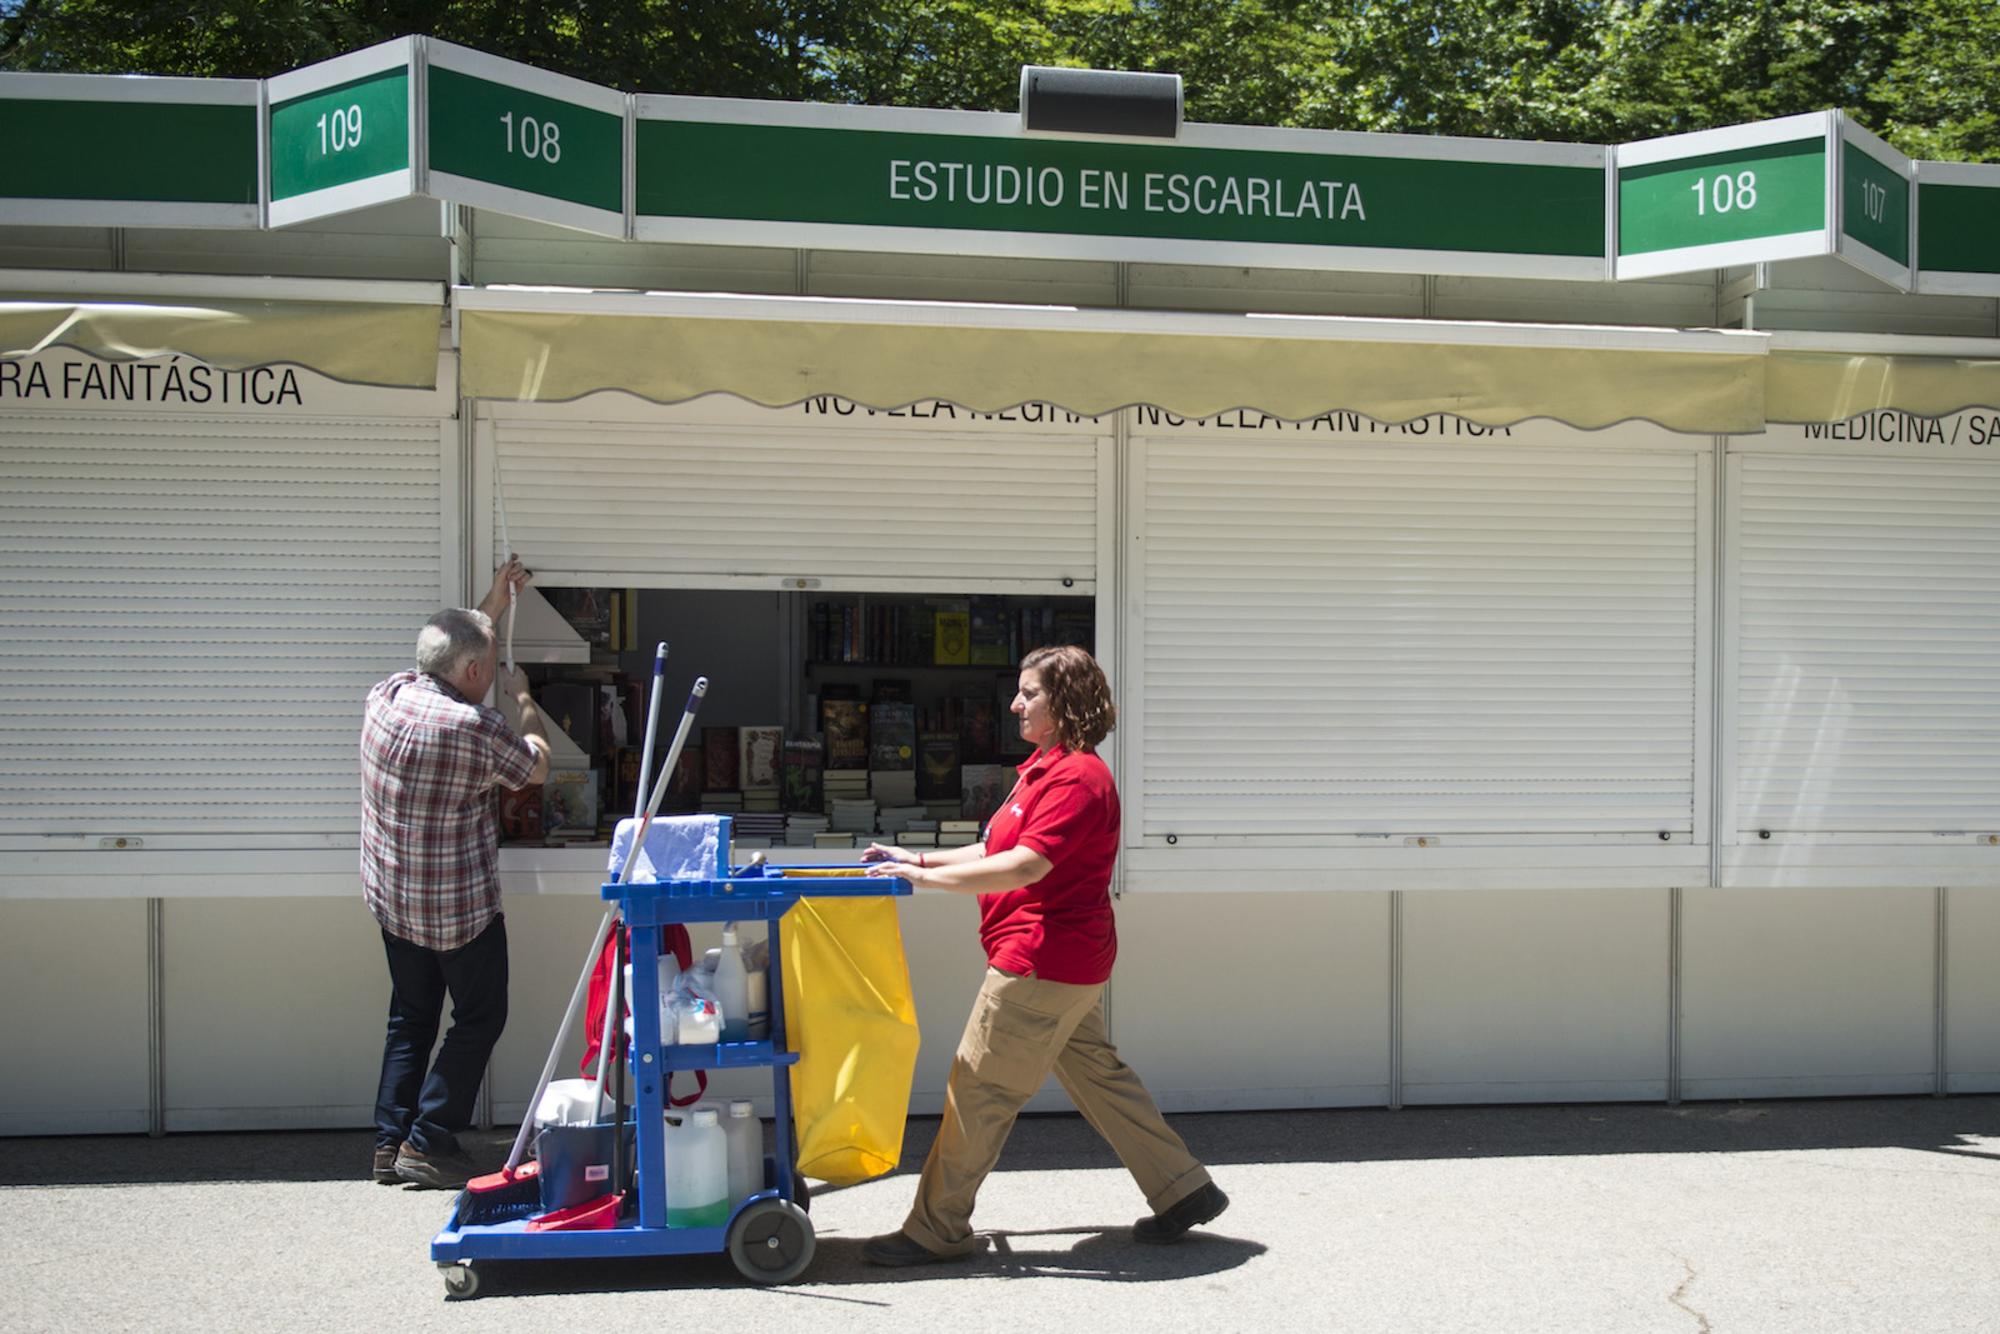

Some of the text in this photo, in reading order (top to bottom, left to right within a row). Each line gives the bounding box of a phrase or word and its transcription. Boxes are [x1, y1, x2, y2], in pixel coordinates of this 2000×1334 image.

[317, 104, 363, 155] 109
[500, 111, 561, 164] 108
[889, 159, 1367, 221] ESTUDIO EN ESCARLATA
[1690, 170, 1757, 216] 108
[1862, 178, 1887, 224] 107
